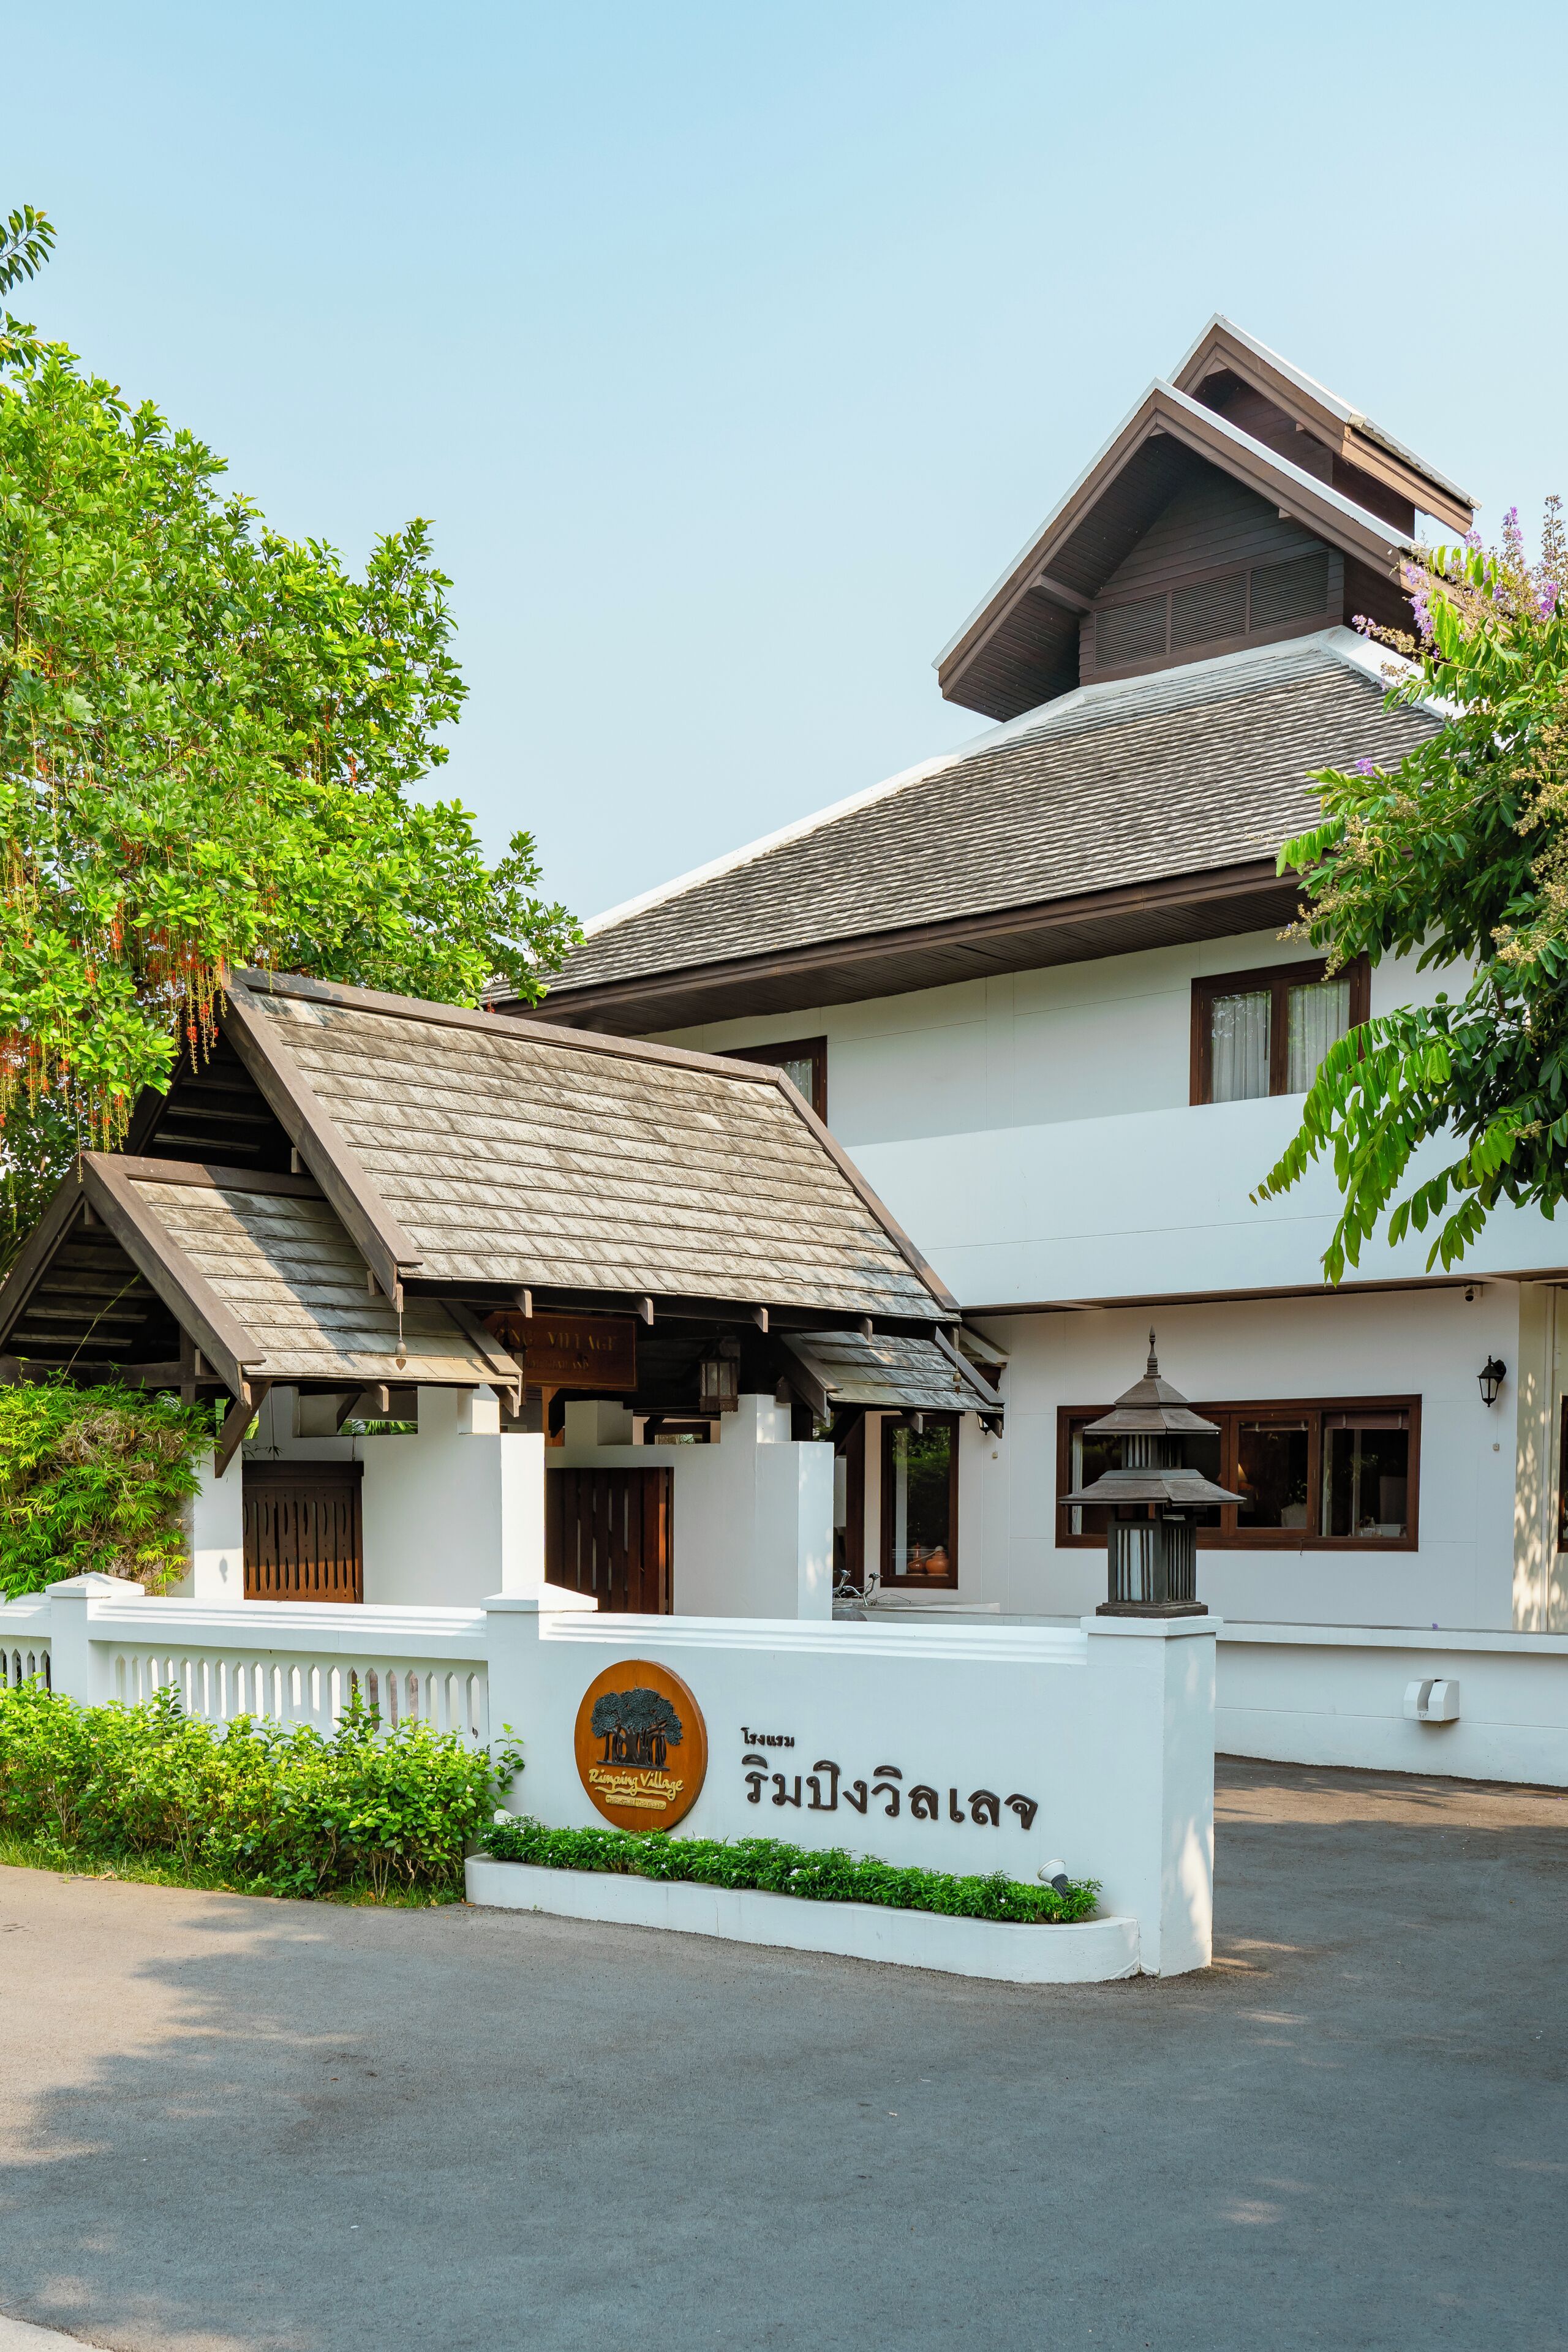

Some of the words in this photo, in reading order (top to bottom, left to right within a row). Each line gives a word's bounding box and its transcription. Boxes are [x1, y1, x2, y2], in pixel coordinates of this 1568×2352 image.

[741, 1727, 795, 1747] โรงแรม
[589, 1769, 638, 1796] Rimping
[640, 1771, 684, 1801] Village
[742, 1753, 1039, 1830] ริมปิงวิลเลจ
